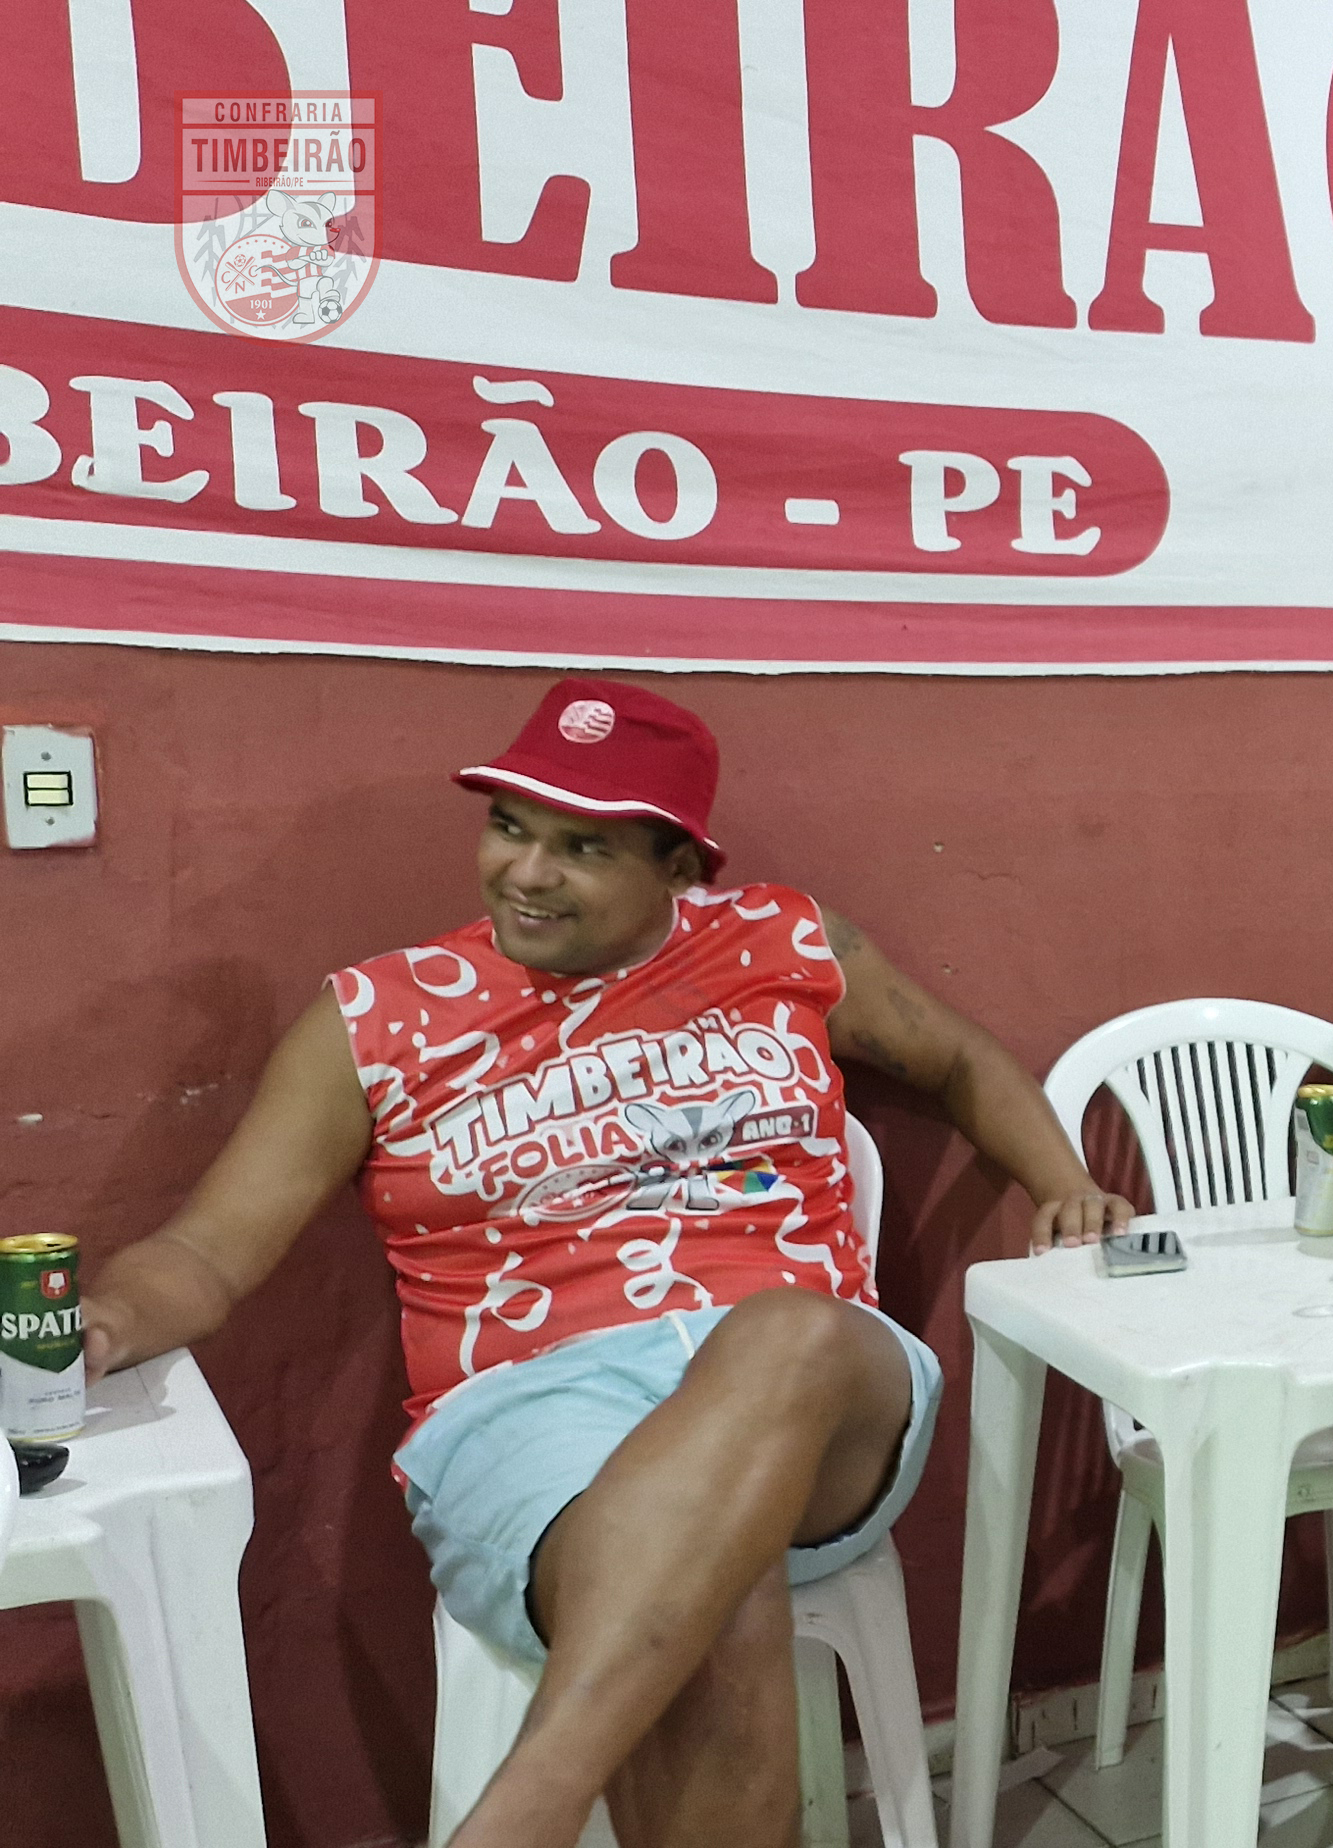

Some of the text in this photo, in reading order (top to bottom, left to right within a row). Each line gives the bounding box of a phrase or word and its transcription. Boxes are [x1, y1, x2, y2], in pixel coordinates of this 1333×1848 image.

[898, 450, 1101, 556] PE
[433, 1014, 791, 1169] TIMBEIRÃO
[478, 1120, 639, 1193] FOLIA
